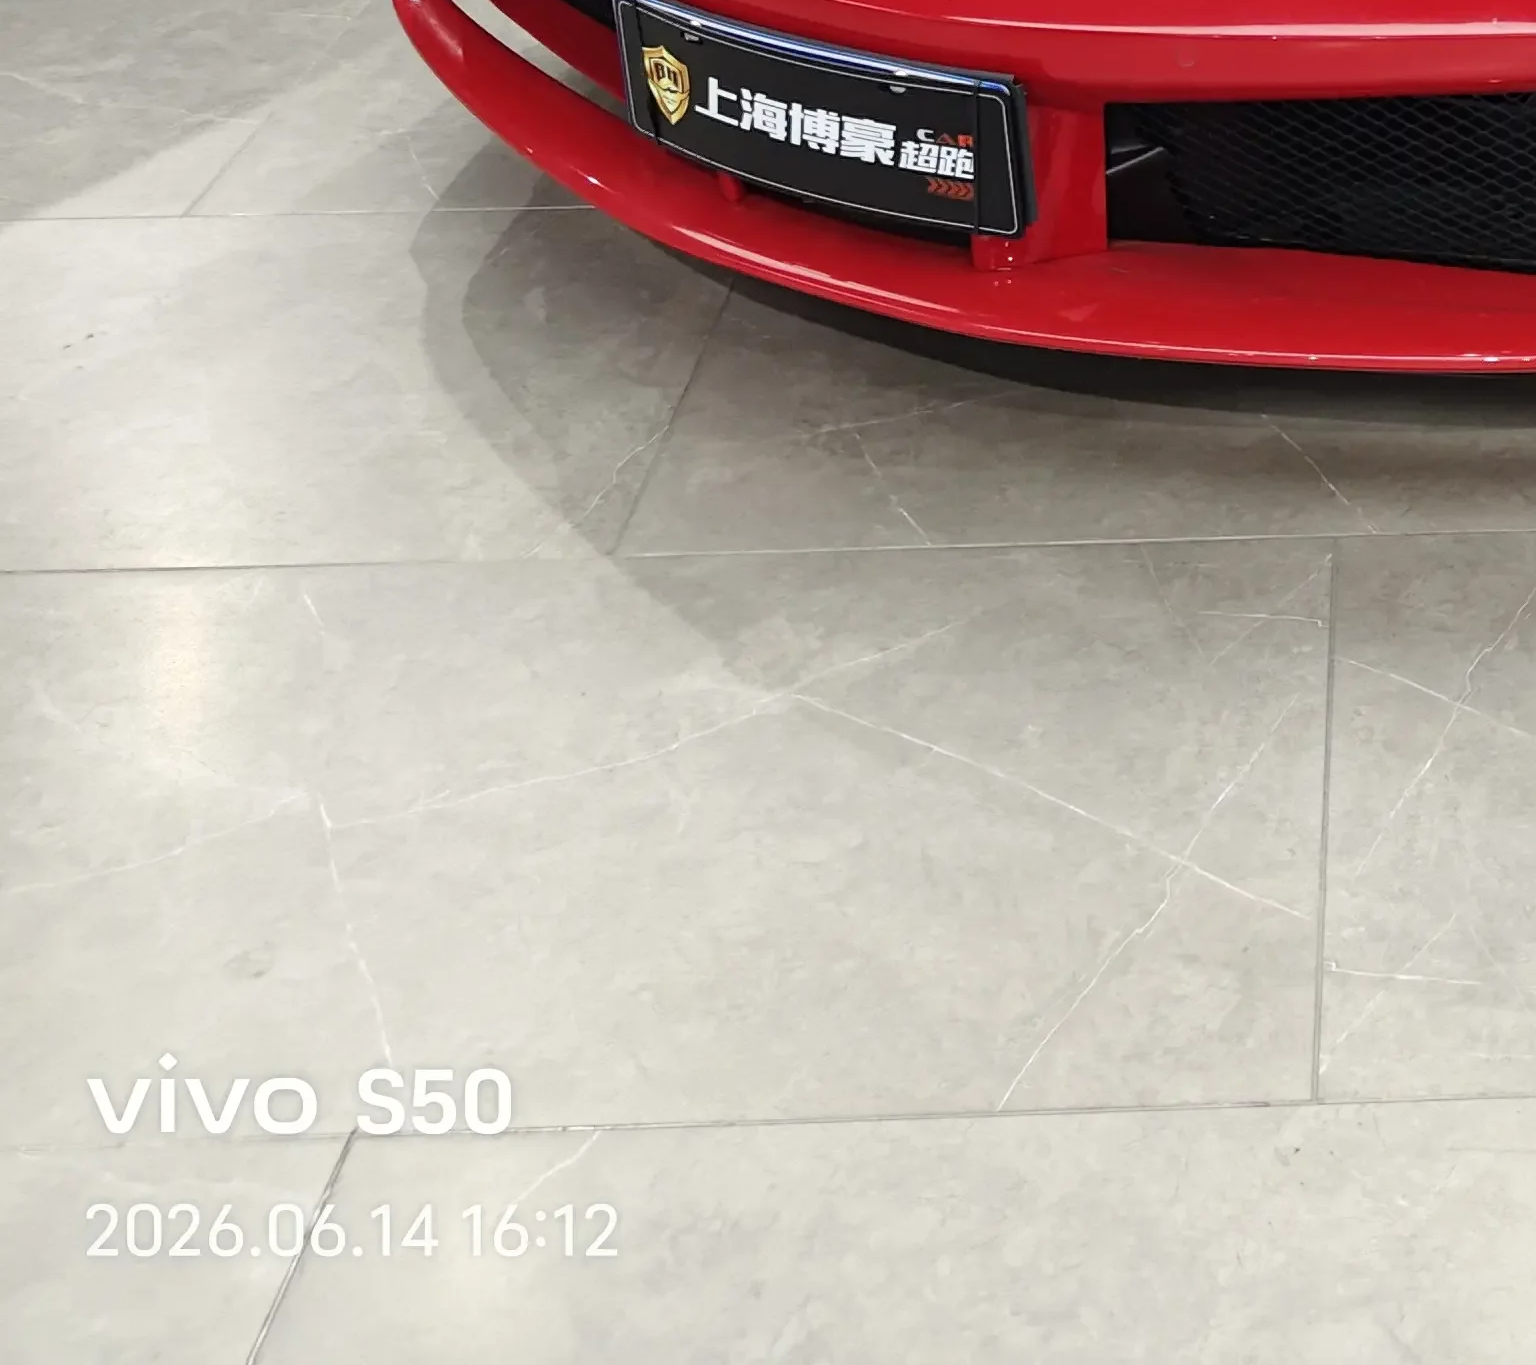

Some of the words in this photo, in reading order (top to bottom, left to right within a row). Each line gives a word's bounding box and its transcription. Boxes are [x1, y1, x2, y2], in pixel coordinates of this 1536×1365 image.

[694, 76, 897, 166] 上海博豪
[899, 141, 975, 180] 超跑
[916, 128, 974, 148] CAR
